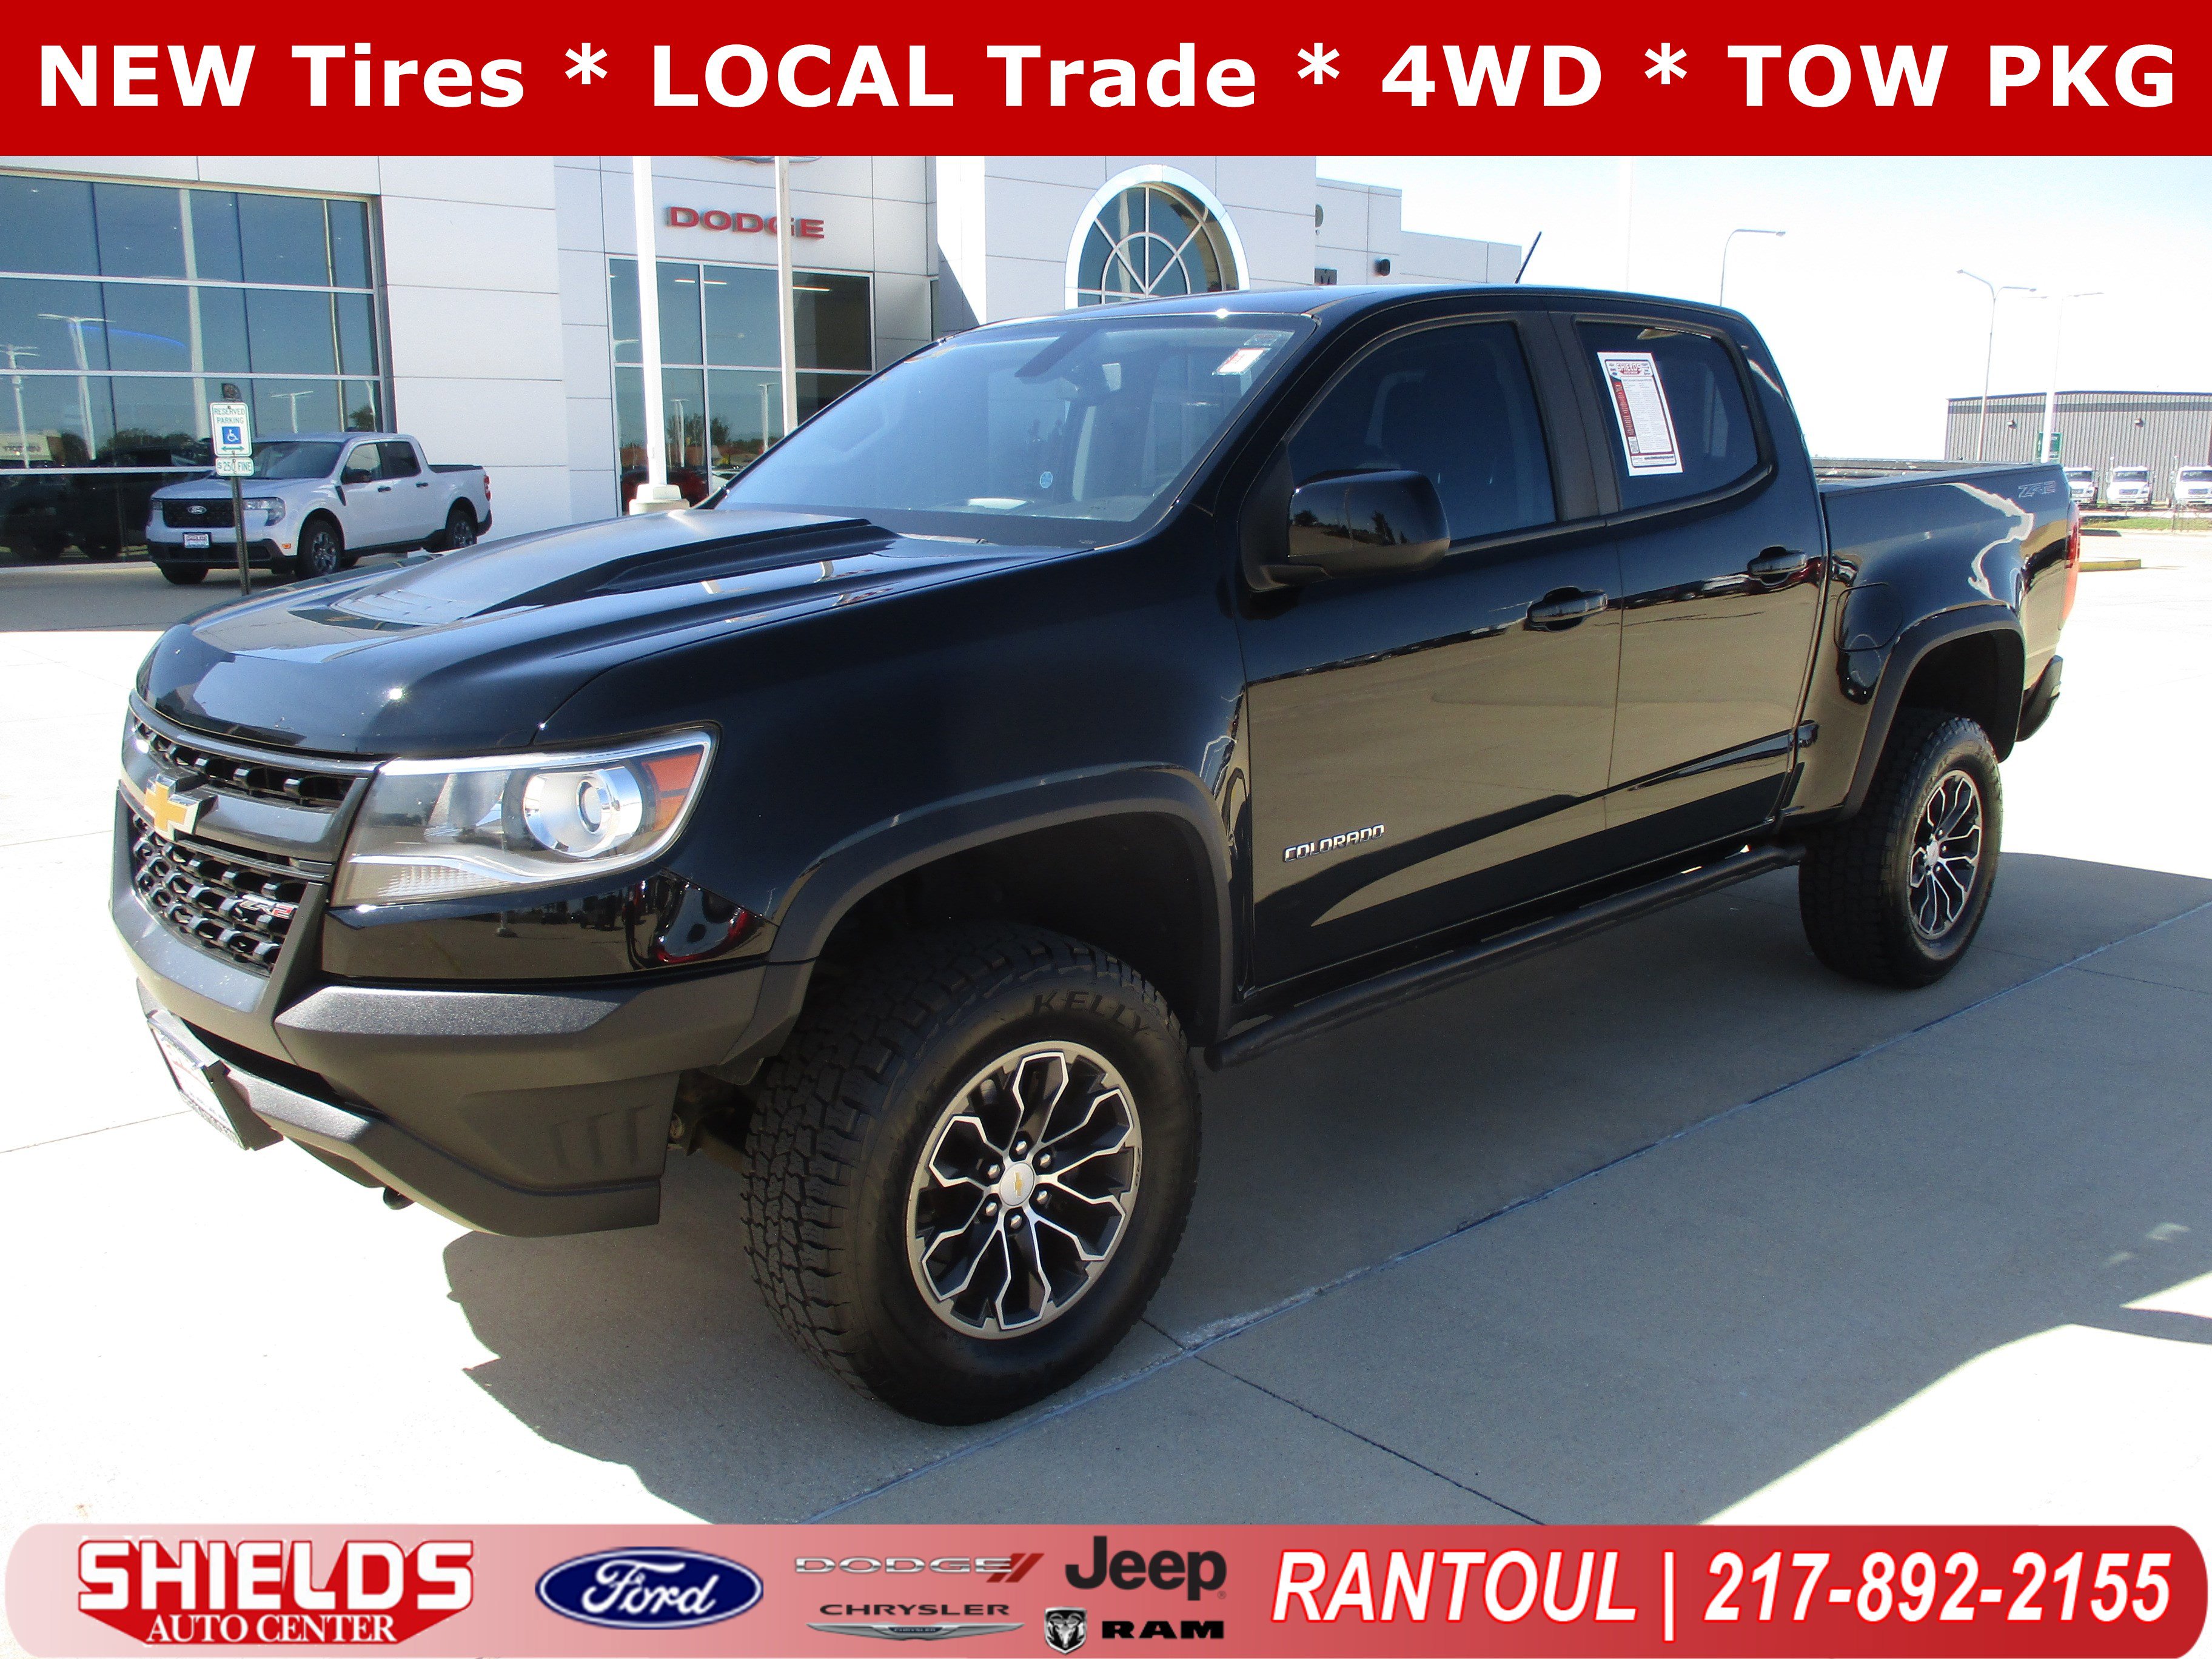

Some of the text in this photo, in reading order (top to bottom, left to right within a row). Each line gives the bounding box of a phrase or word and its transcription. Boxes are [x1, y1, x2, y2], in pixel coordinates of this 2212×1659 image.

[238, 461, 253, 471] FINE
[1283, 823, 1385, 862] COLORADO
[1032, 988, 1151, 1034] KELLY
